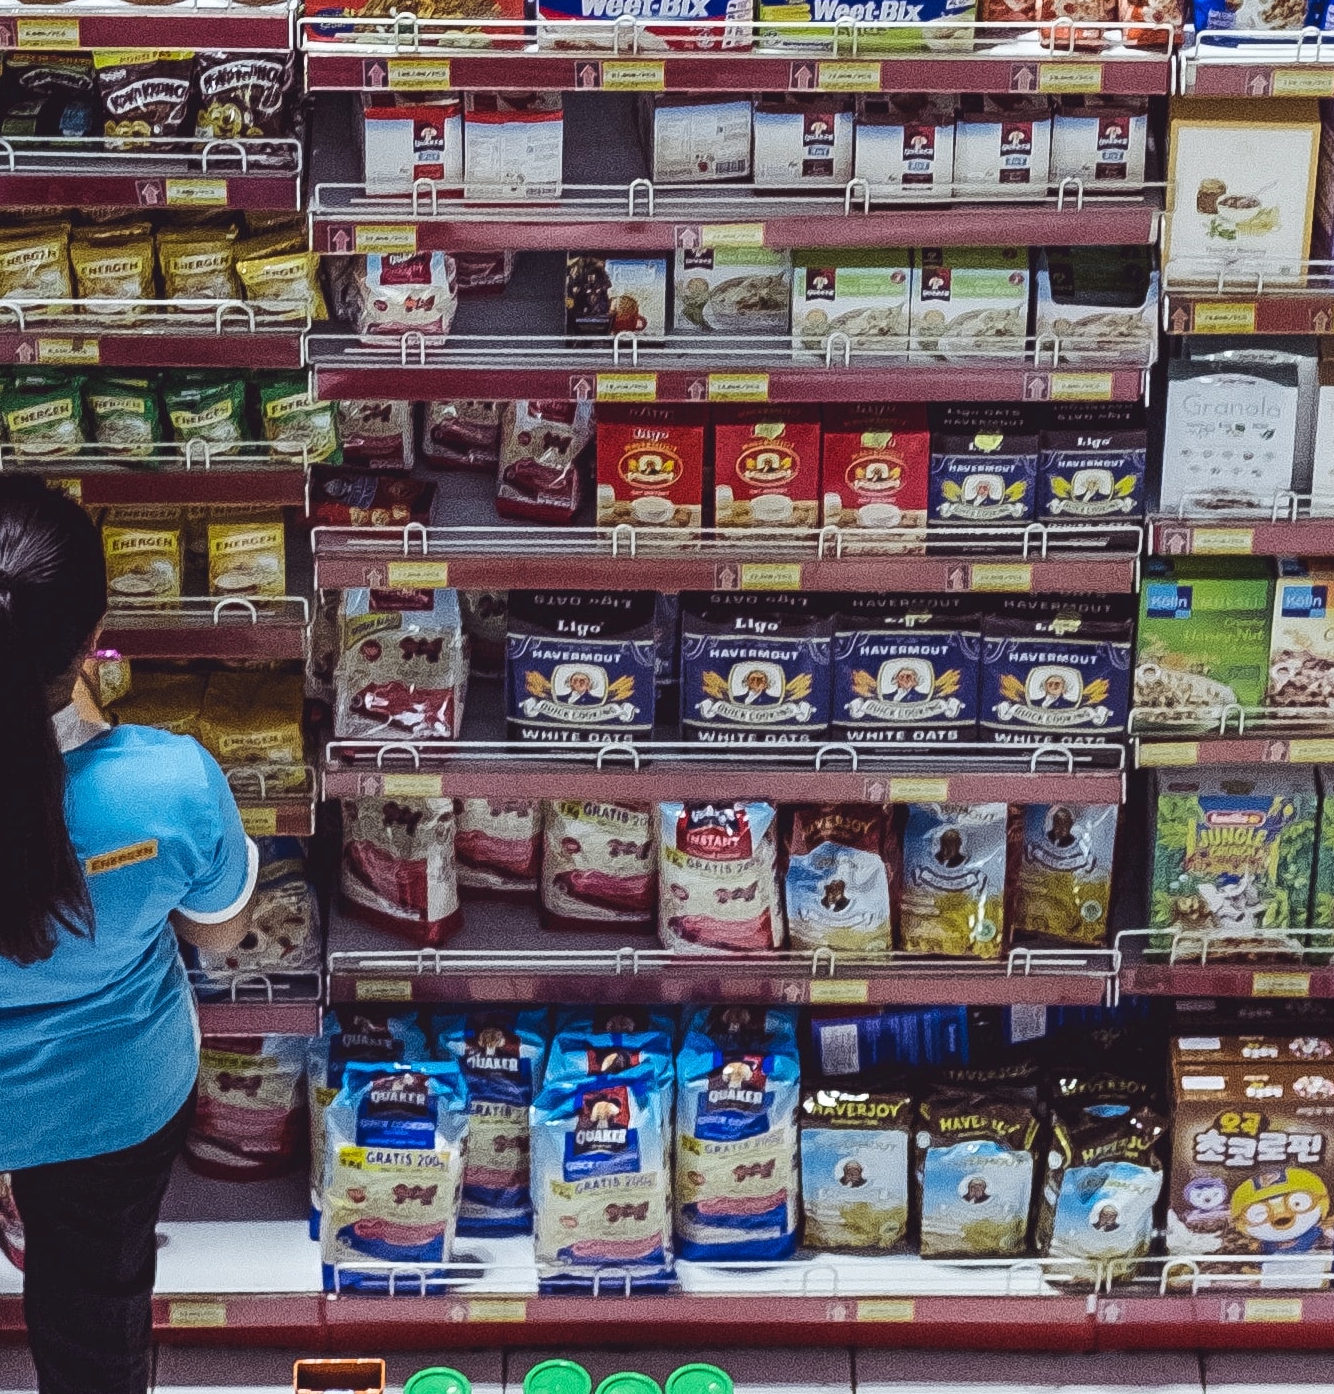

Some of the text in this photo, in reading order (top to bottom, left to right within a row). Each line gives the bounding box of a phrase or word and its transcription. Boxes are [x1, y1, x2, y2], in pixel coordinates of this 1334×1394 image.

[814, 0, 925, 22] Weet-Bix
[557, 619, 602, 637] Ligo
[735, 619, 779, 632] Ligo
[532, 649, 621, 664] HAVERMOUT
[710, 648, 798, 661] HAVERMOUT
[860, 644, 949, 656] HAVERMOUT
[1009, 652, 1098, 665] HAVERMOUT
[521, 729, 634, 743] WHITE OATS
[698, 731, 811, 743] WHITE OATS
[847, 729, 959, 742] WHITE OATS
[371, 1091, 426, 1106] QUAKER
[708, 1088, 764, 1105] QUAKER
[810, 1099, 903, 1120] HAVERJOY
[575, 1128, 627, 1145] QUAKER
[574, 1177, 621, 1195] GRATIS
